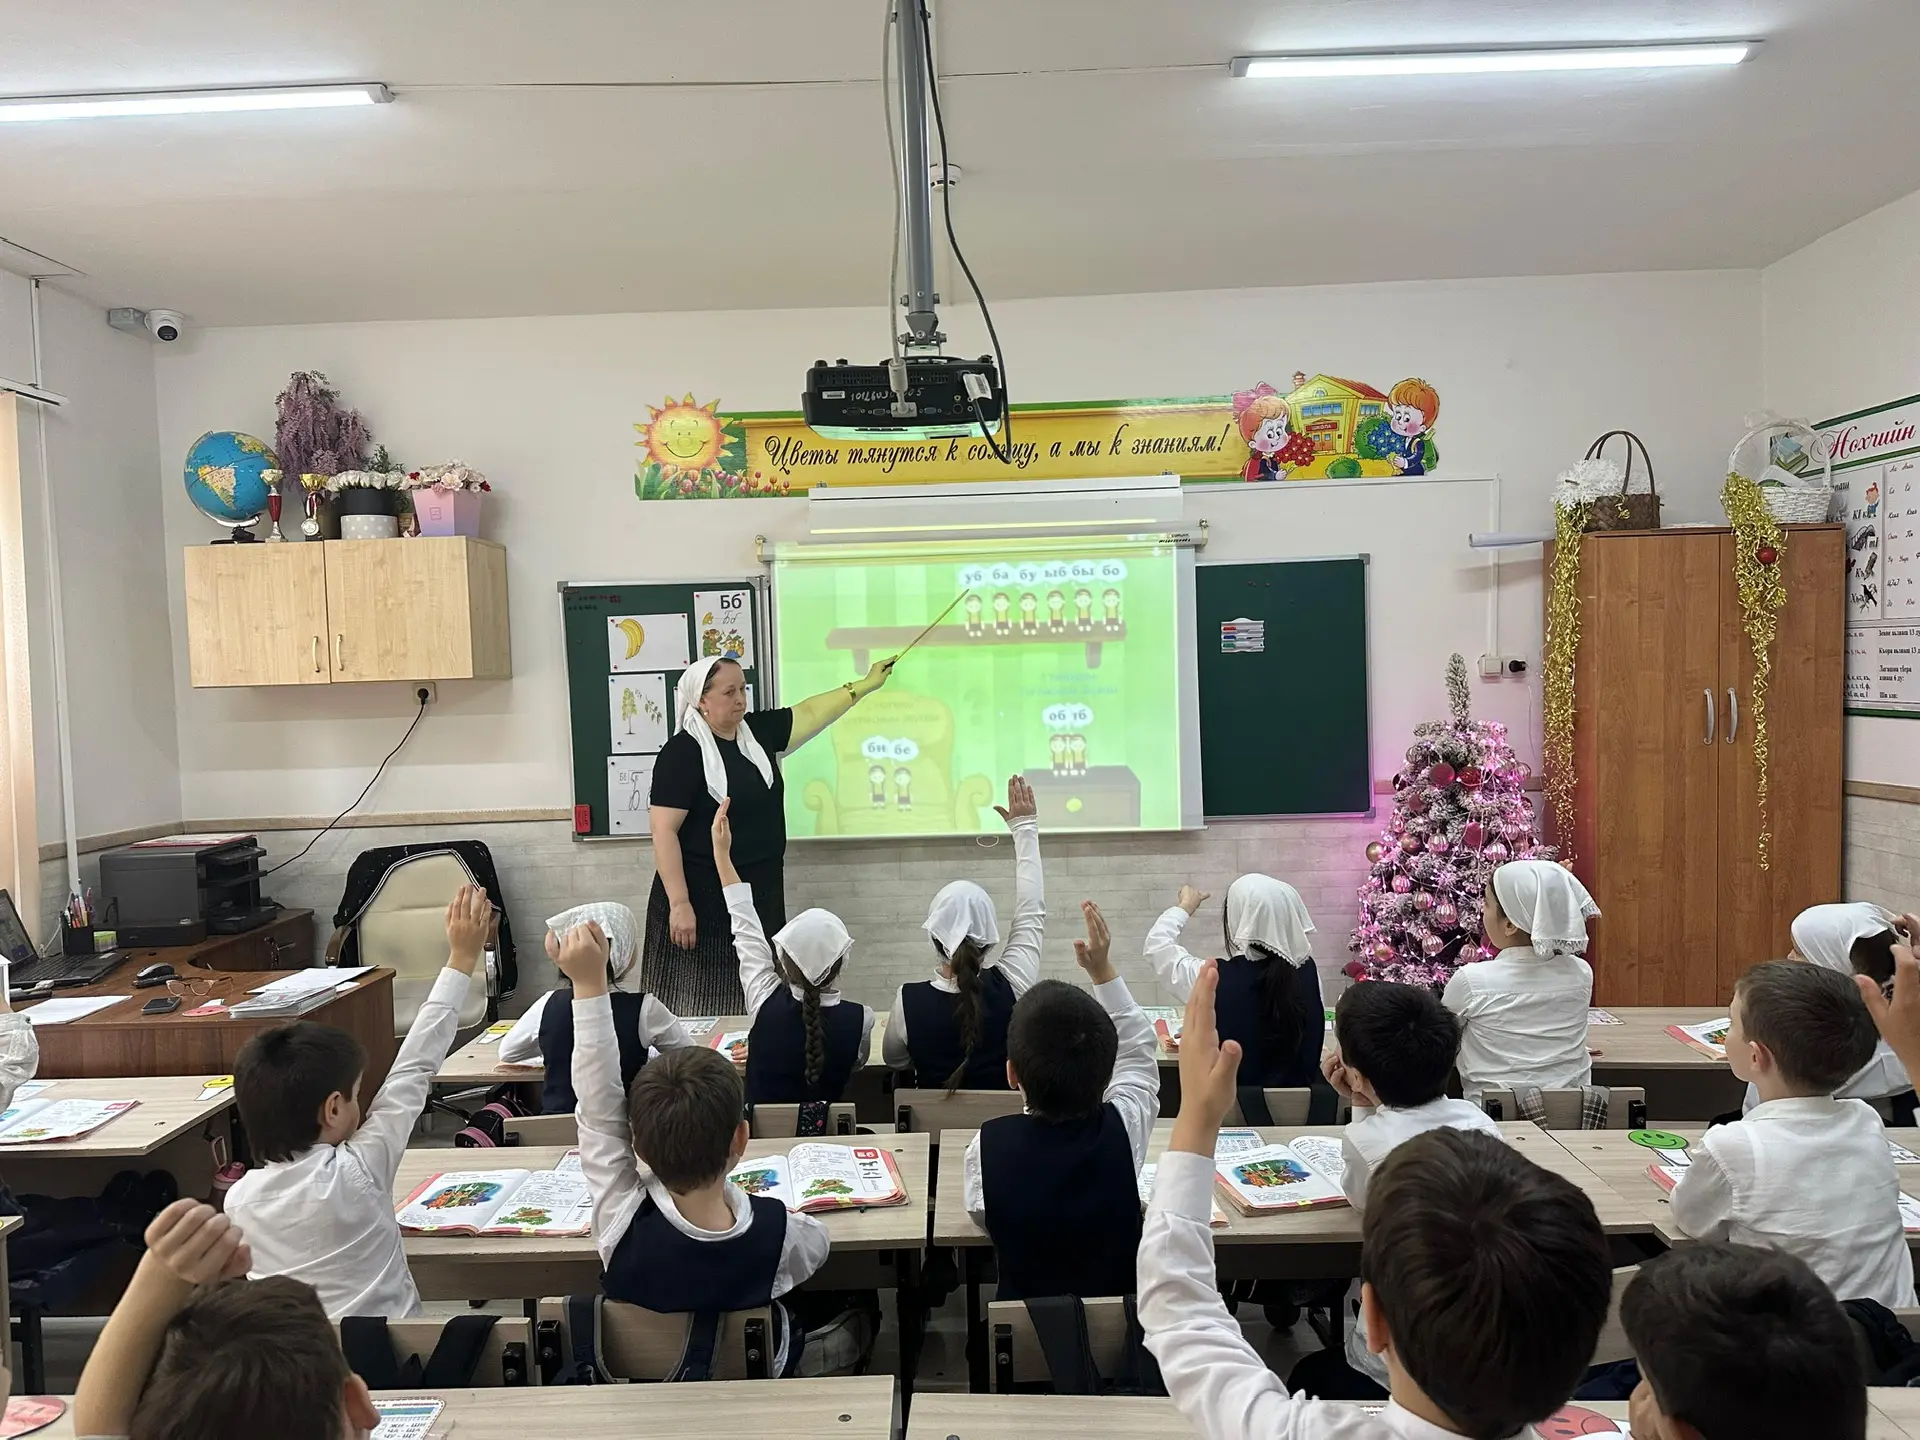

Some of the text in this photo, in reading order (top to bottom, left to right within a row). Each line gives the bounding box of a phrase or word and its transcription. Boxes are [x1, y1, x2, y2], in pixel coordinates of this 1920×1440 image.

[764, 436, 839, 475] Цветы
[847, 444, 938, 474] тянутся
[945, 438, 959, 462] к
[1049, 443, 1061, 457] а
[1069, 440, 1101, 457] мы
[1108, 424, 1130, 457] к
[1131, 423, 1231, 455] знаниям!
[1810, 419, 1916, 463] Нохчийн
[964, 564, 1120, 585] уб ба бу ыб бы бо
[720, 593, 742, 610] Бб
[1048, 709, 1066, 721] об
[894, 744, 912, 755] бе
